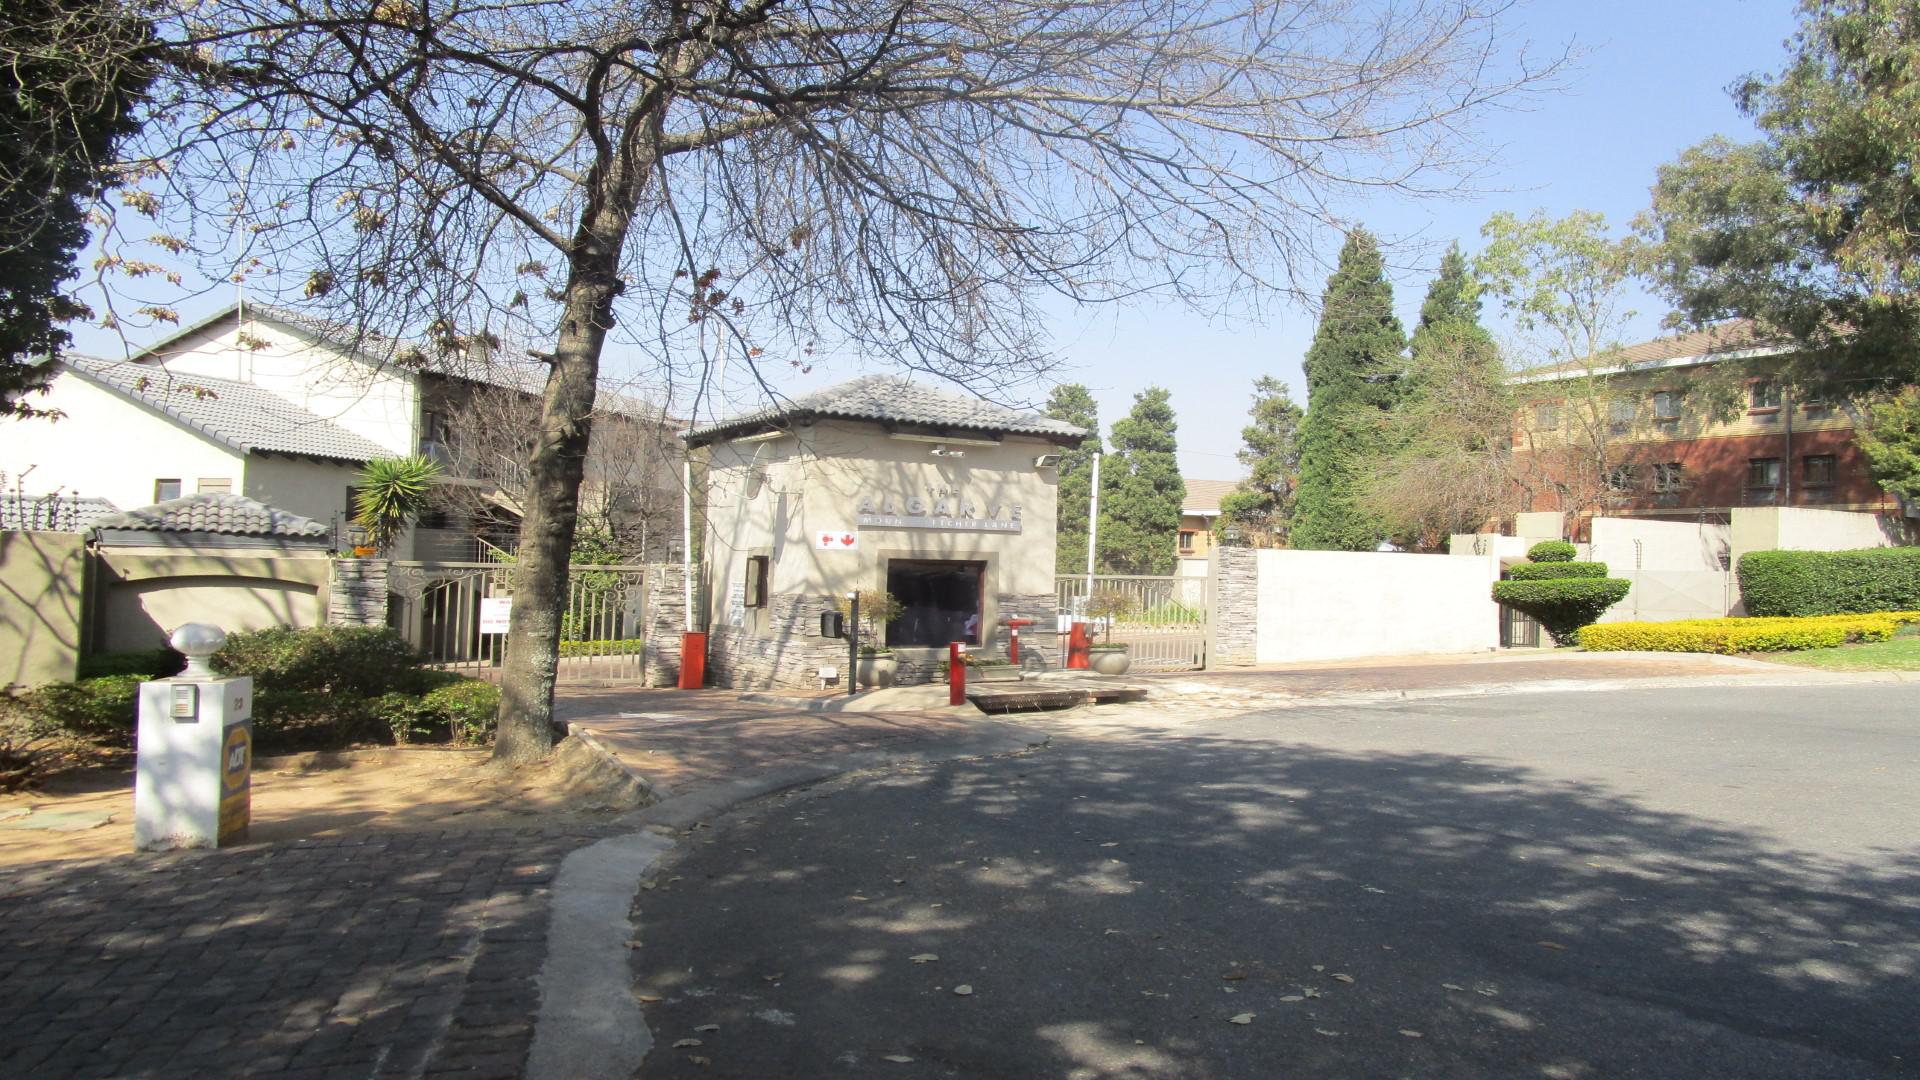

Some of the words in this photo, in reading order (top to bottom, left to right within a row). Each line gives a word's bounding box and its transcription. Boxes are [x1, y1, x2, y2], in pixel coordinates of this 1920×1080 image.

[925, 485, 961, 499] THE
[857, 495, 1022, 521] ALGARVE
[863, 516, 907, 526] MOUN
[983, 521, 1017, 529] LANE
[228, 746, 246, 770] ADT
